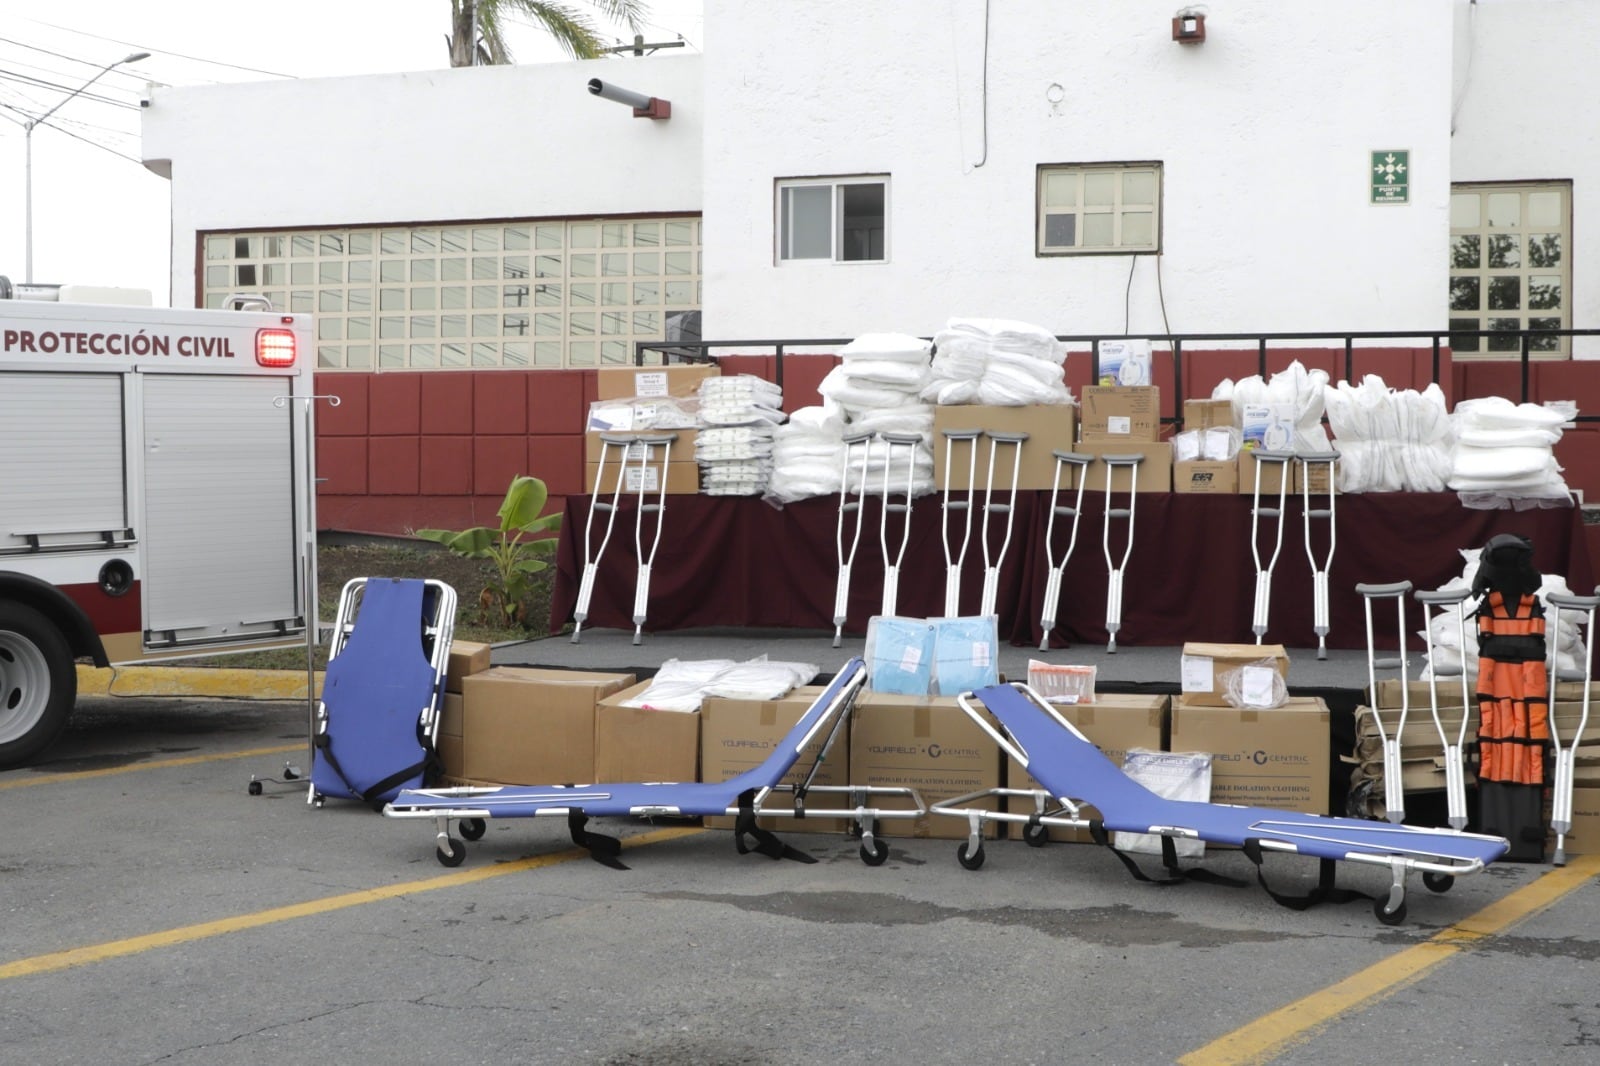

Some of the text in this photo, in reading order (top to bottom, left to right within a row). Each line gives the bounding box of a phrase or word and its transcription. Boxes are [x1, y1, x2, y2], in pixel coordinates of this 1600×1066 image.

[4, 329, 235, 358] PROTECCIÓN CIVIL
[1212, 753, 1241, 762] FIELD
[1269, 754, 1309, 762] CENTRIC
[1233, 784, 1271, 792] ISOLATION
[1272, 785, 1310, 793] CLOTHING
